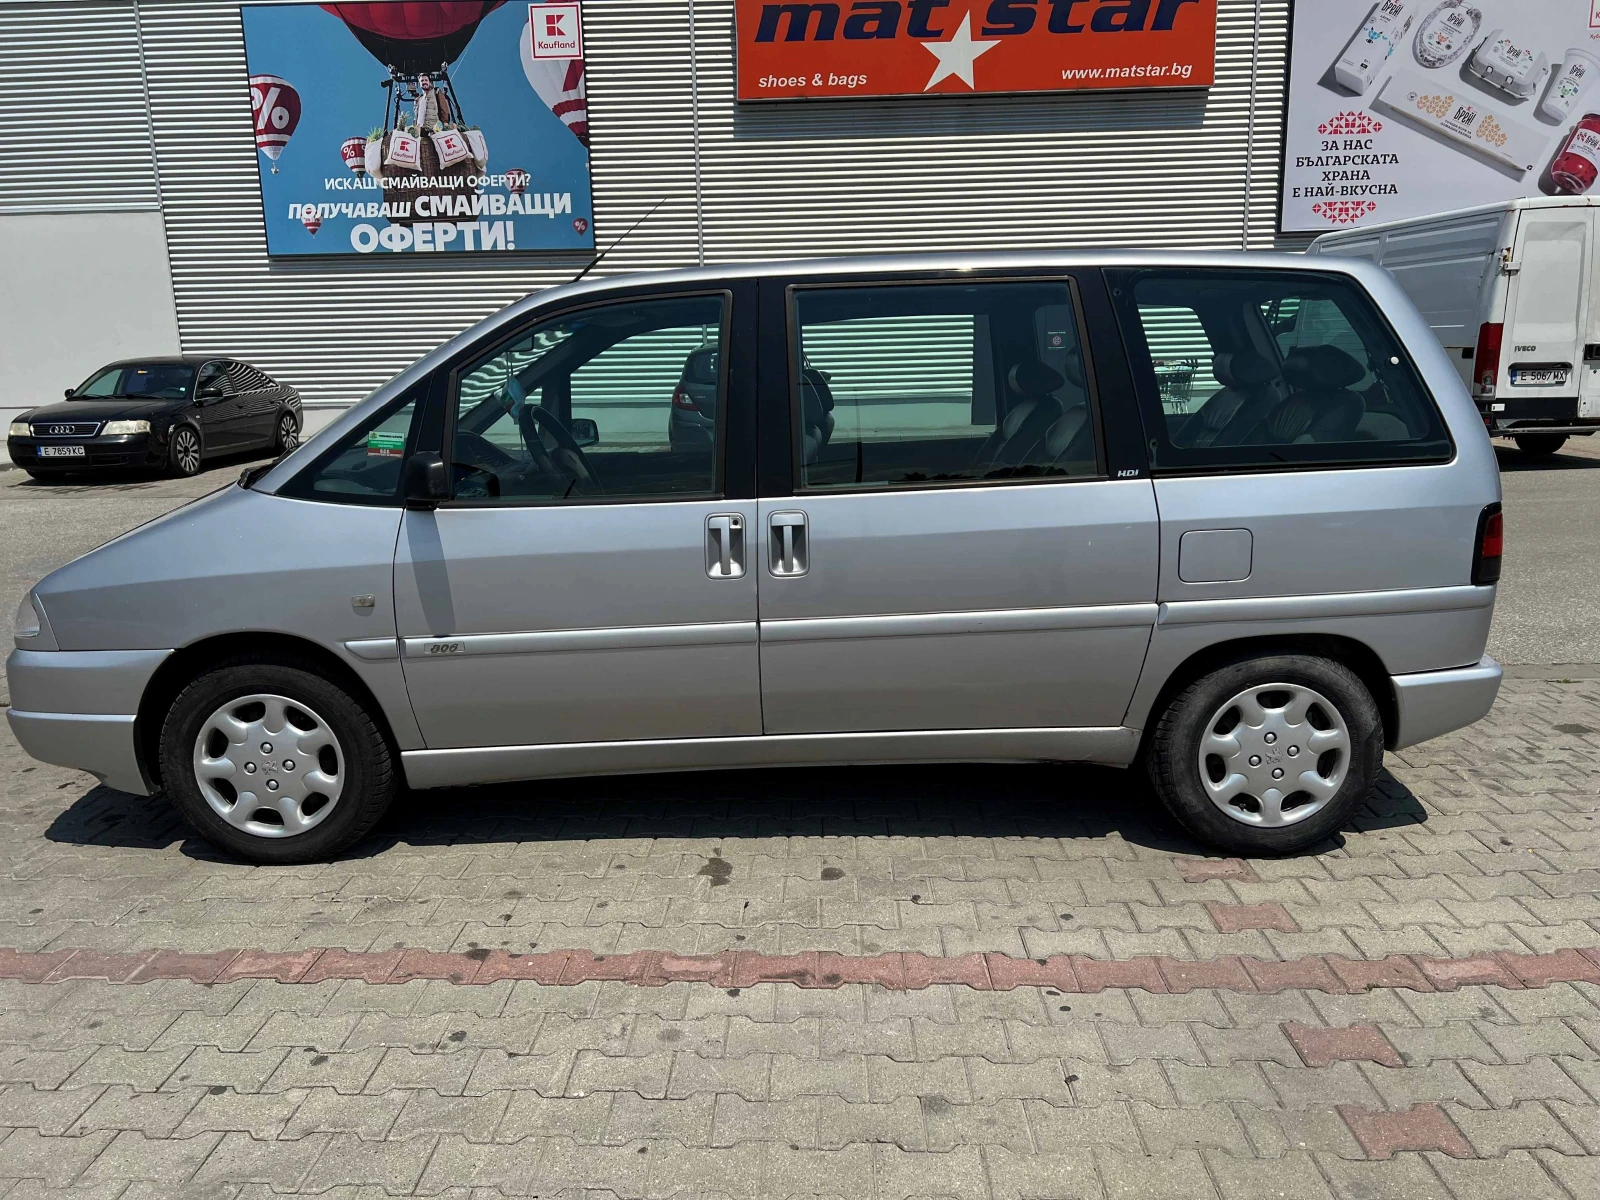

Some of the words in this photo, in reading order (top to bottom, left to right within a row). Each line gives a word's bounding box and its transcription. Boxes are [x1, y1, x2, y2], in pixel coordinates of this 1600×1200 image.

[754, 0, 949, 42] mat
[981, 0, 1199, 36] star
[538, 41, 575, 49] Kaufland
[1062, 63, 1192, 79] www.matstar.bg
[758, 74, 806, 87] shoes
[812, 73, 823, 86] &
[828, 73, 867, 88] bags
[1321, 141, 1339, 151] ЗА
[1343, 139, 1373, 150] НАС
[1296, 153, 1399, 167] БЪЛГАРСКАТА
[325, 177, 377, 190] ИСКАШ
[381, 174, 464, 190] СМАЙВАЩИ
[467, 173, 531, 187] ОФЕРТИ?
[1321, 170, 1371, 181] ХРАНА
[1292, 187, 1301, 198] Е
[1304, 182, 1398, 197] НАЙ-ВКУСНА
[288, 202, 411, 219] ПОЛУЧАВАШ
[415, 188, 572, 218] СМАЙВАЩИ
[350, 220, 516, 253] ОФЕРТИ!
[1117, 469, 1139, 477] HDI
[430, 644, 458, 653] 806
